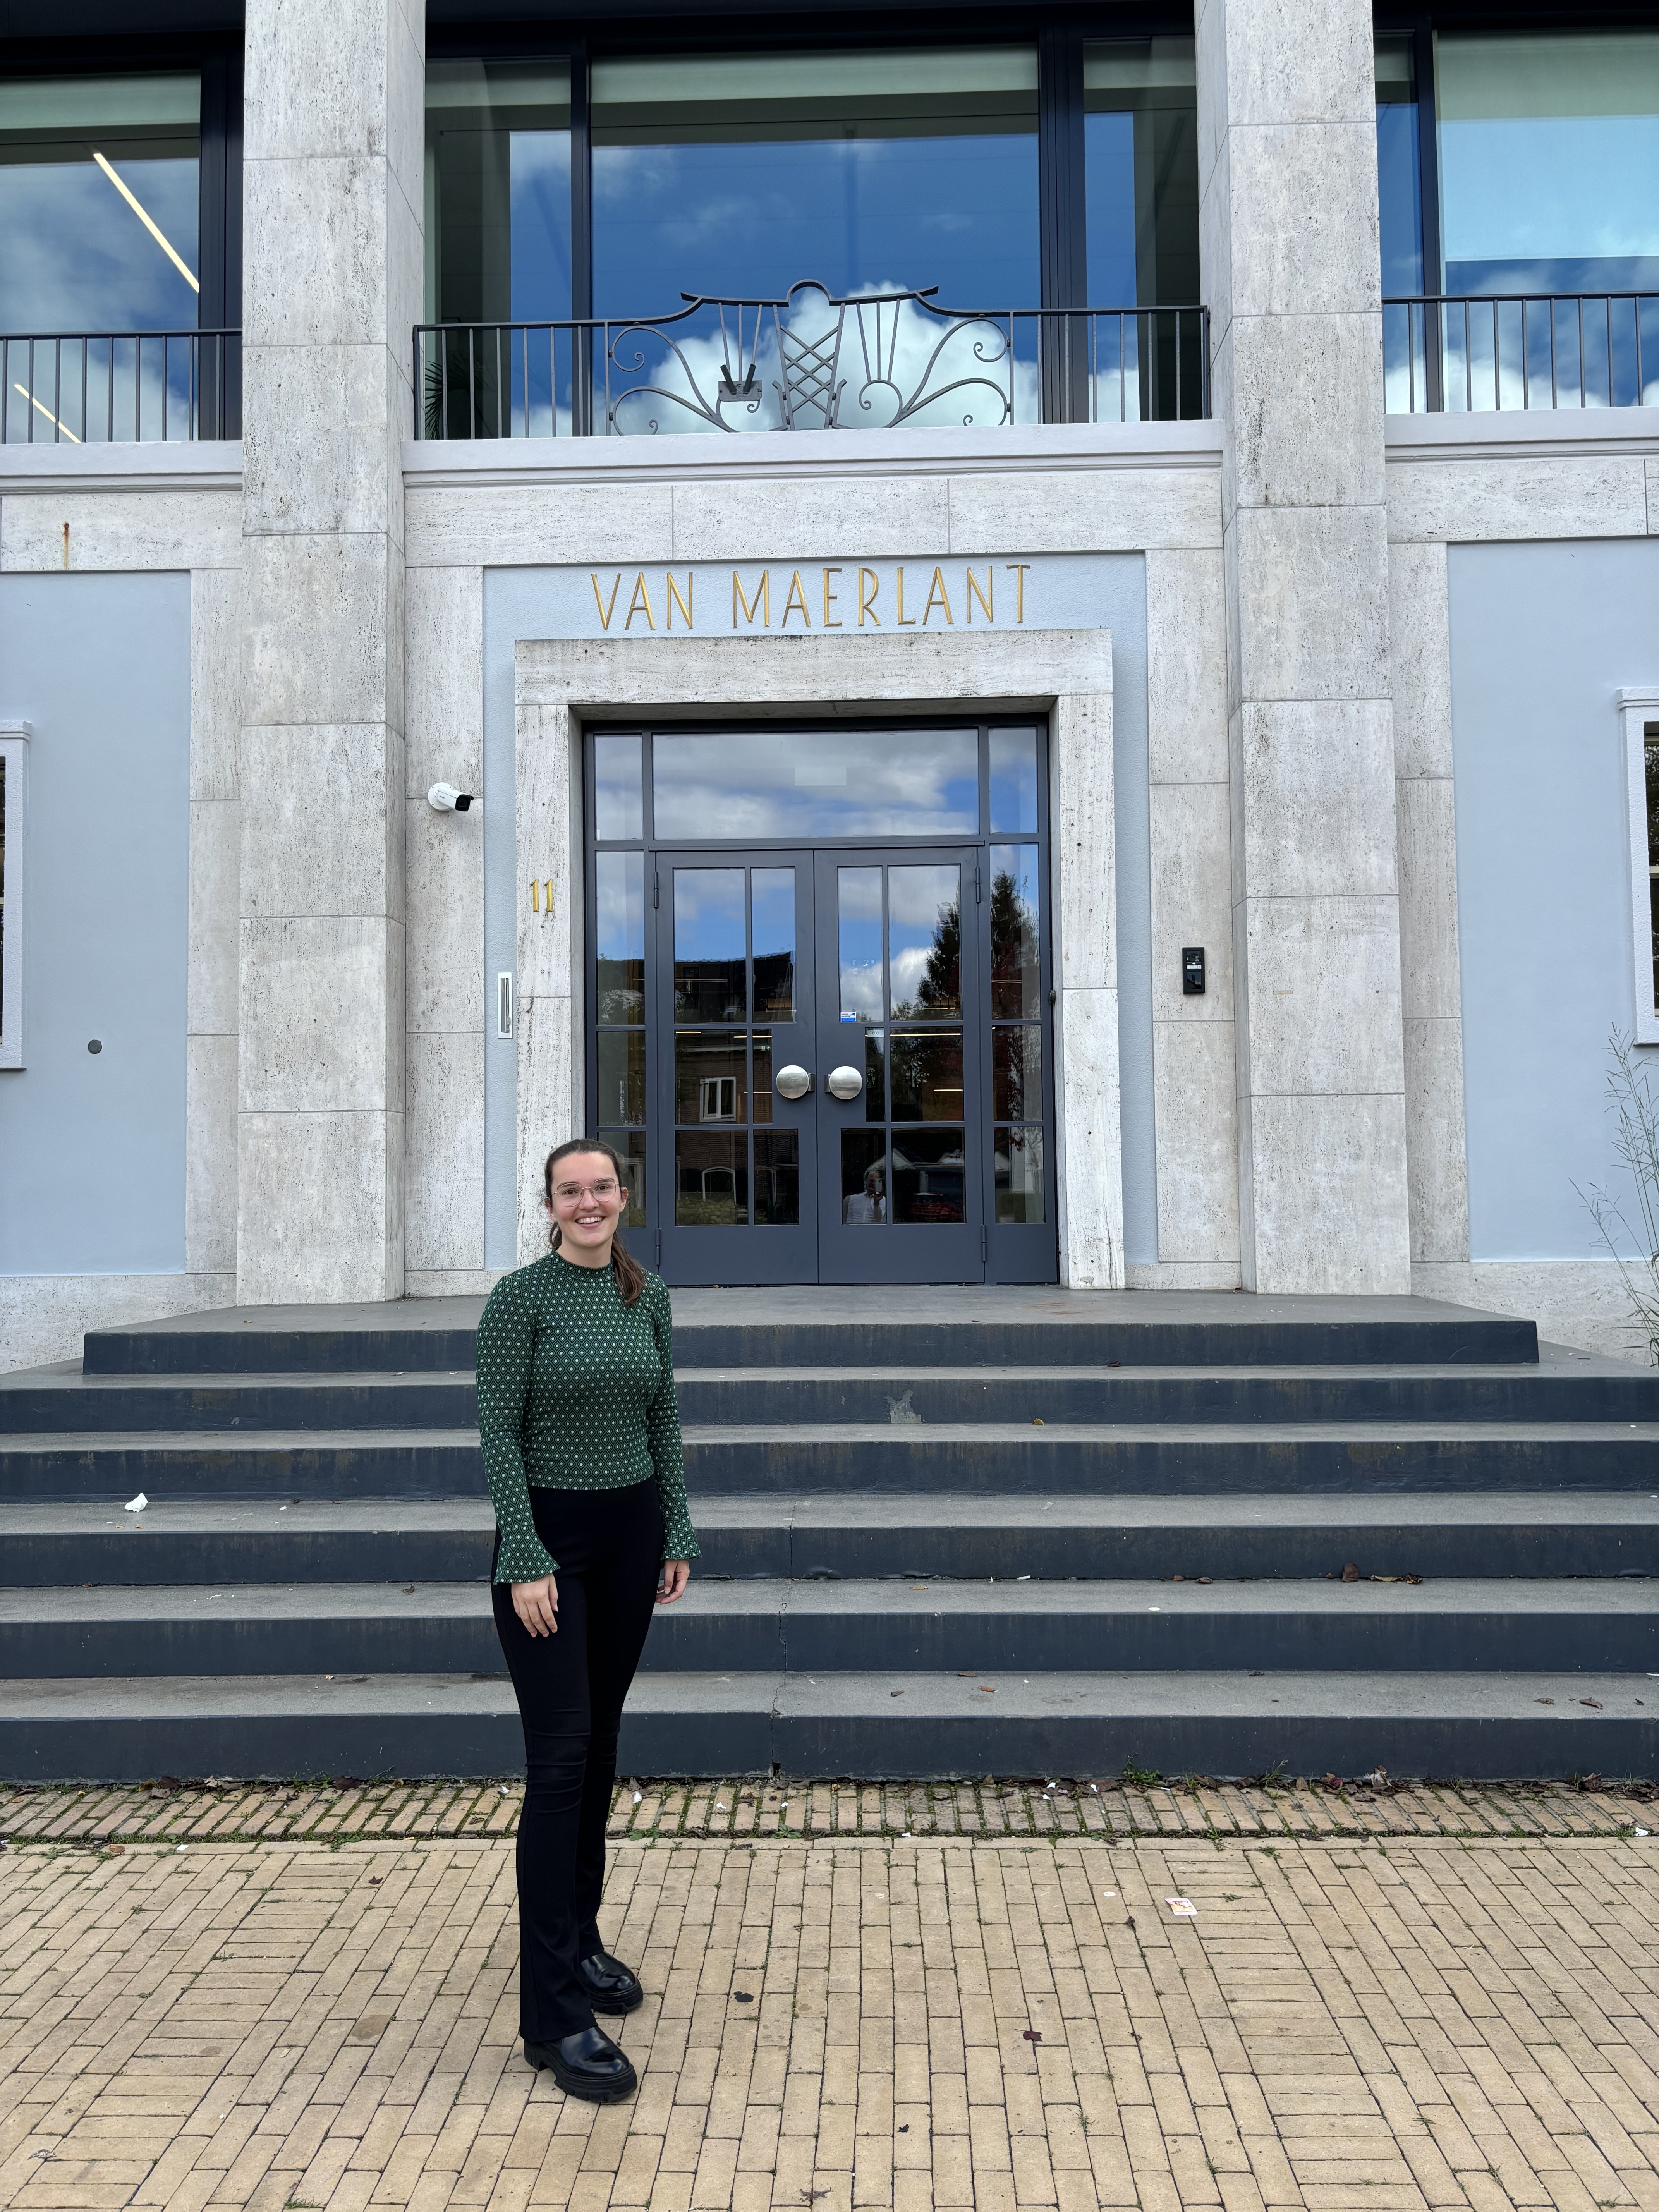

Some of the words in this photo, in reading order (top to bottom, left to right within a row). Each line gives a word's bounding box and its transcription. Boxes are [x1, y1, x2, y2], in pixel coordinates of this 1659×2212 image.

[591, 571, 694, 630] VAN
[733, 564, 1031, 628] MAERLANT
[530, 879, 553, 912] 11
